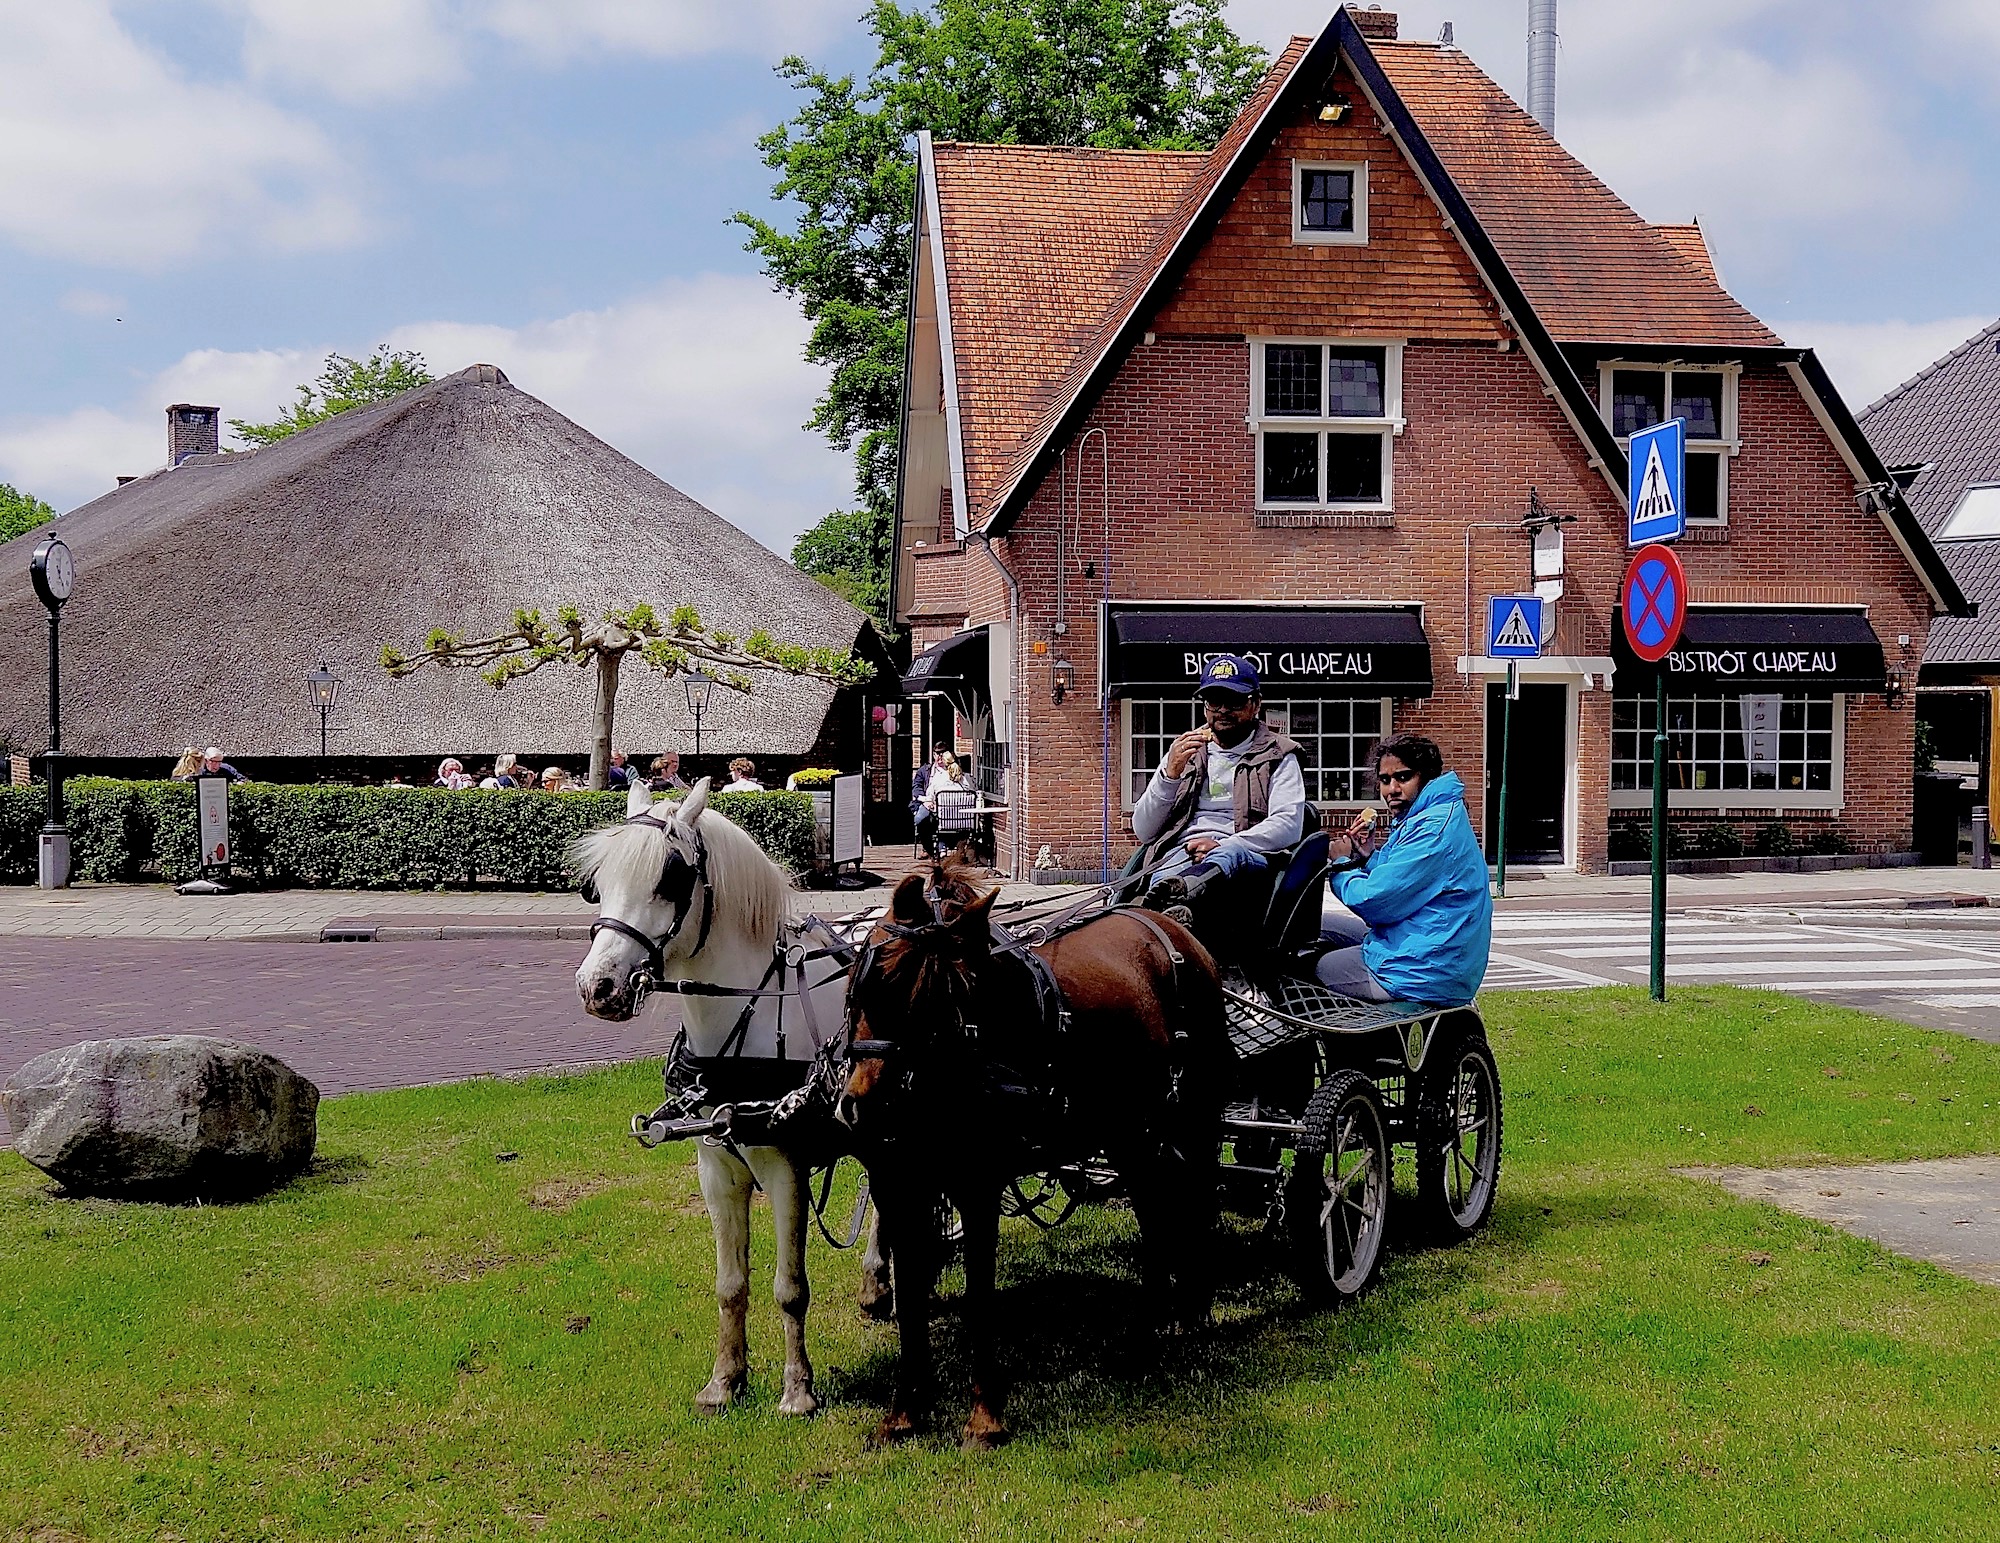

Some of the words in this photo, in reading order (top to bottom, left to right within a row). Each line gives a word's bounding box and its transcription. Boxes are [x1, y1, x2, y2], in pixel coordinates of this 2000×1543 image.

[1184, 651, 1272, 675] BISÔT
[1279, 652, 1372, 675] CHAPEAU
[1669, 650, 1747, 674] BISTRÔT
[1753, 652, 1837, 673] CHAPEAU
